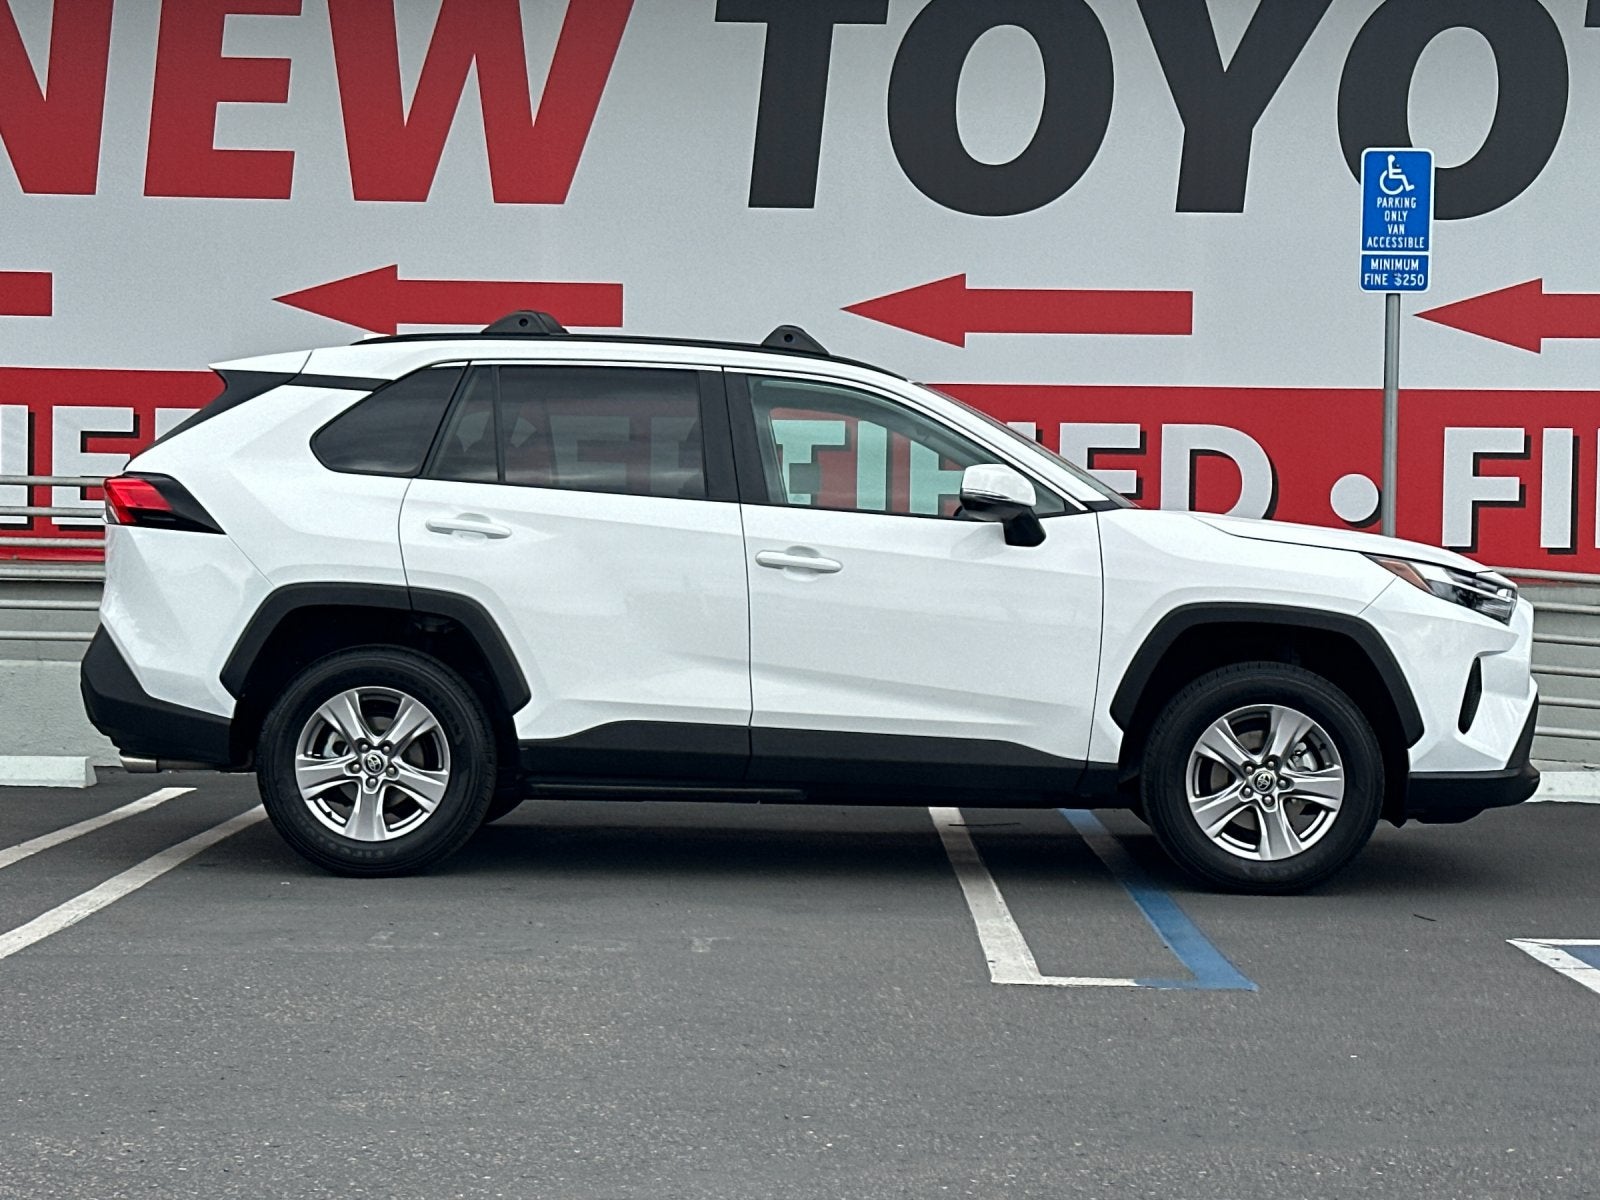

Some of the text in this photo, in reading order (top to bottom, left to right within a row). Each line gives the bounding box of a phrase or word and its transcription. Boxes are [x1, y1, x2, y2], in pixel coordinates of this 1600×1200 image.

[0, 0, 1600, 220] NEW TOYO
[1377, 197, 1416, 208] PARKING
[1384, 210, 1408, 222] ONLY
[1387, 223, 1405, 235] VAN
[1366, 237, 1425, 248] ACCESSIBLE
[1370, 258, 1419, 271] MINIMUM
[1364, 273, 1425, 286] FINE $250
[1442, 427, 1600, 549] FI
